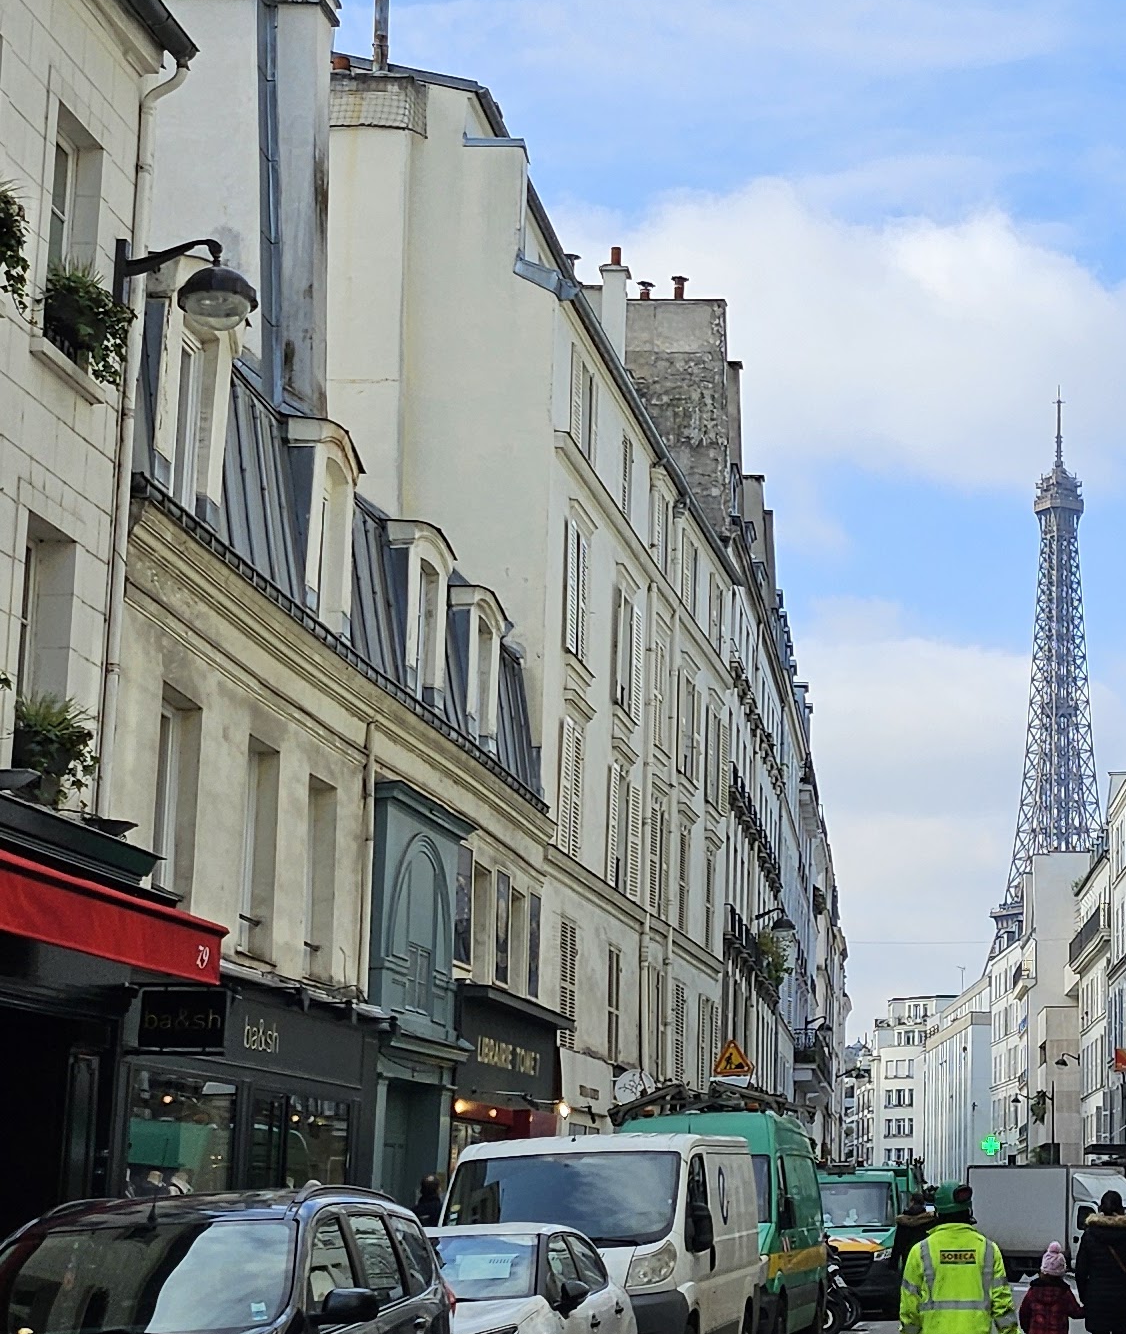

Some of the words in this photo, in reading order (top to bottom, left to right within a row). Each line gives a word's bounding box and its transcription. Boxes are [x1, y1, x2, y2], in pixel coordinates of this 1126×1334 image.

[144, 1008, 221, 1030] ba&sh
[243, 1015, 280, 1054] ba&sh
[941, 1252, 975, 1260] SOBECA
